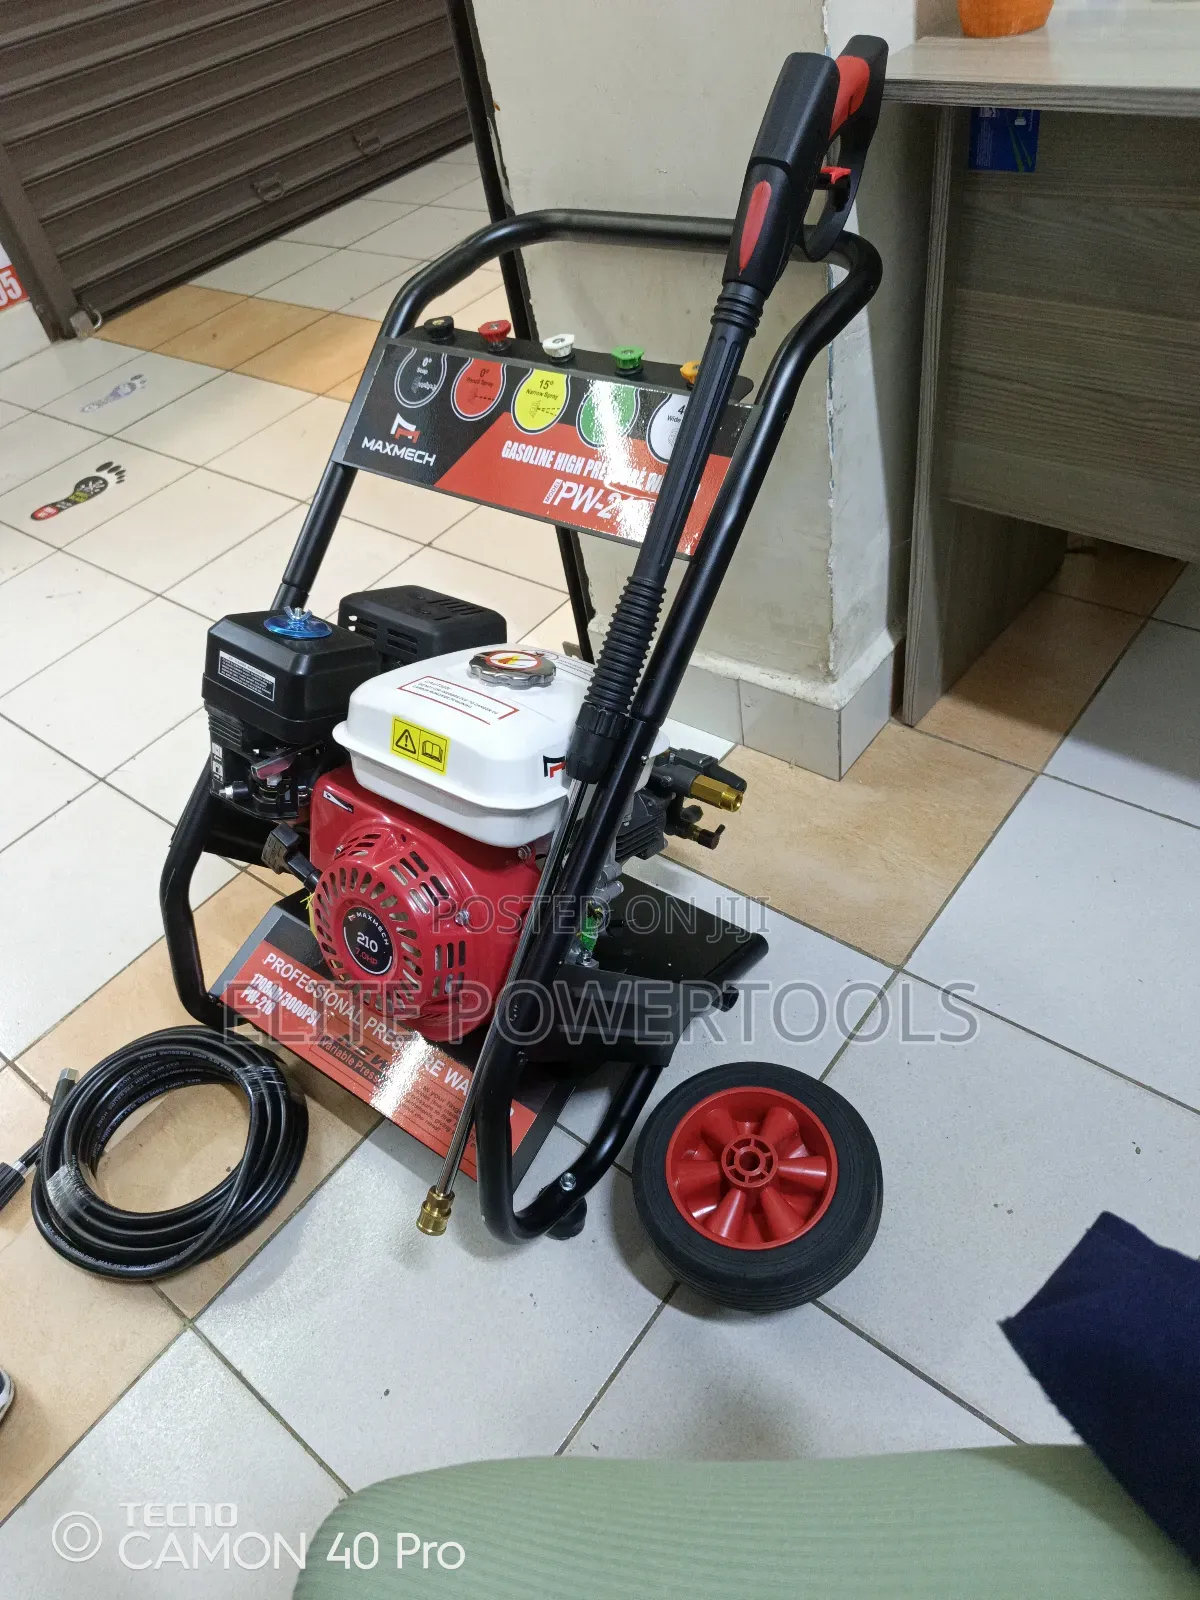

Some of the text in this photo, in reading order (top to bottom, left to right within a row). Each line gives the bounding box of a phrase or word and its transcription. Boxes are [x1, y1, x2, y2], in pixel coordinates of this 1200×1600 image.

[525, 389, 560, 401] Narrow Spray
[667, 415, 681, 423] Wide
[361, 436, 437, 467] MAXMECH
[501, 440, 557, 470] GASOLINE
[553, 450, 586, 476] HIGH
[545, 479, 563, 504] MODEL
[356, 911, 390, 946] MAXMECH
[356, 931, 379, 953] 210
[263, 952, 364, 1026] PROFESSIONAL
